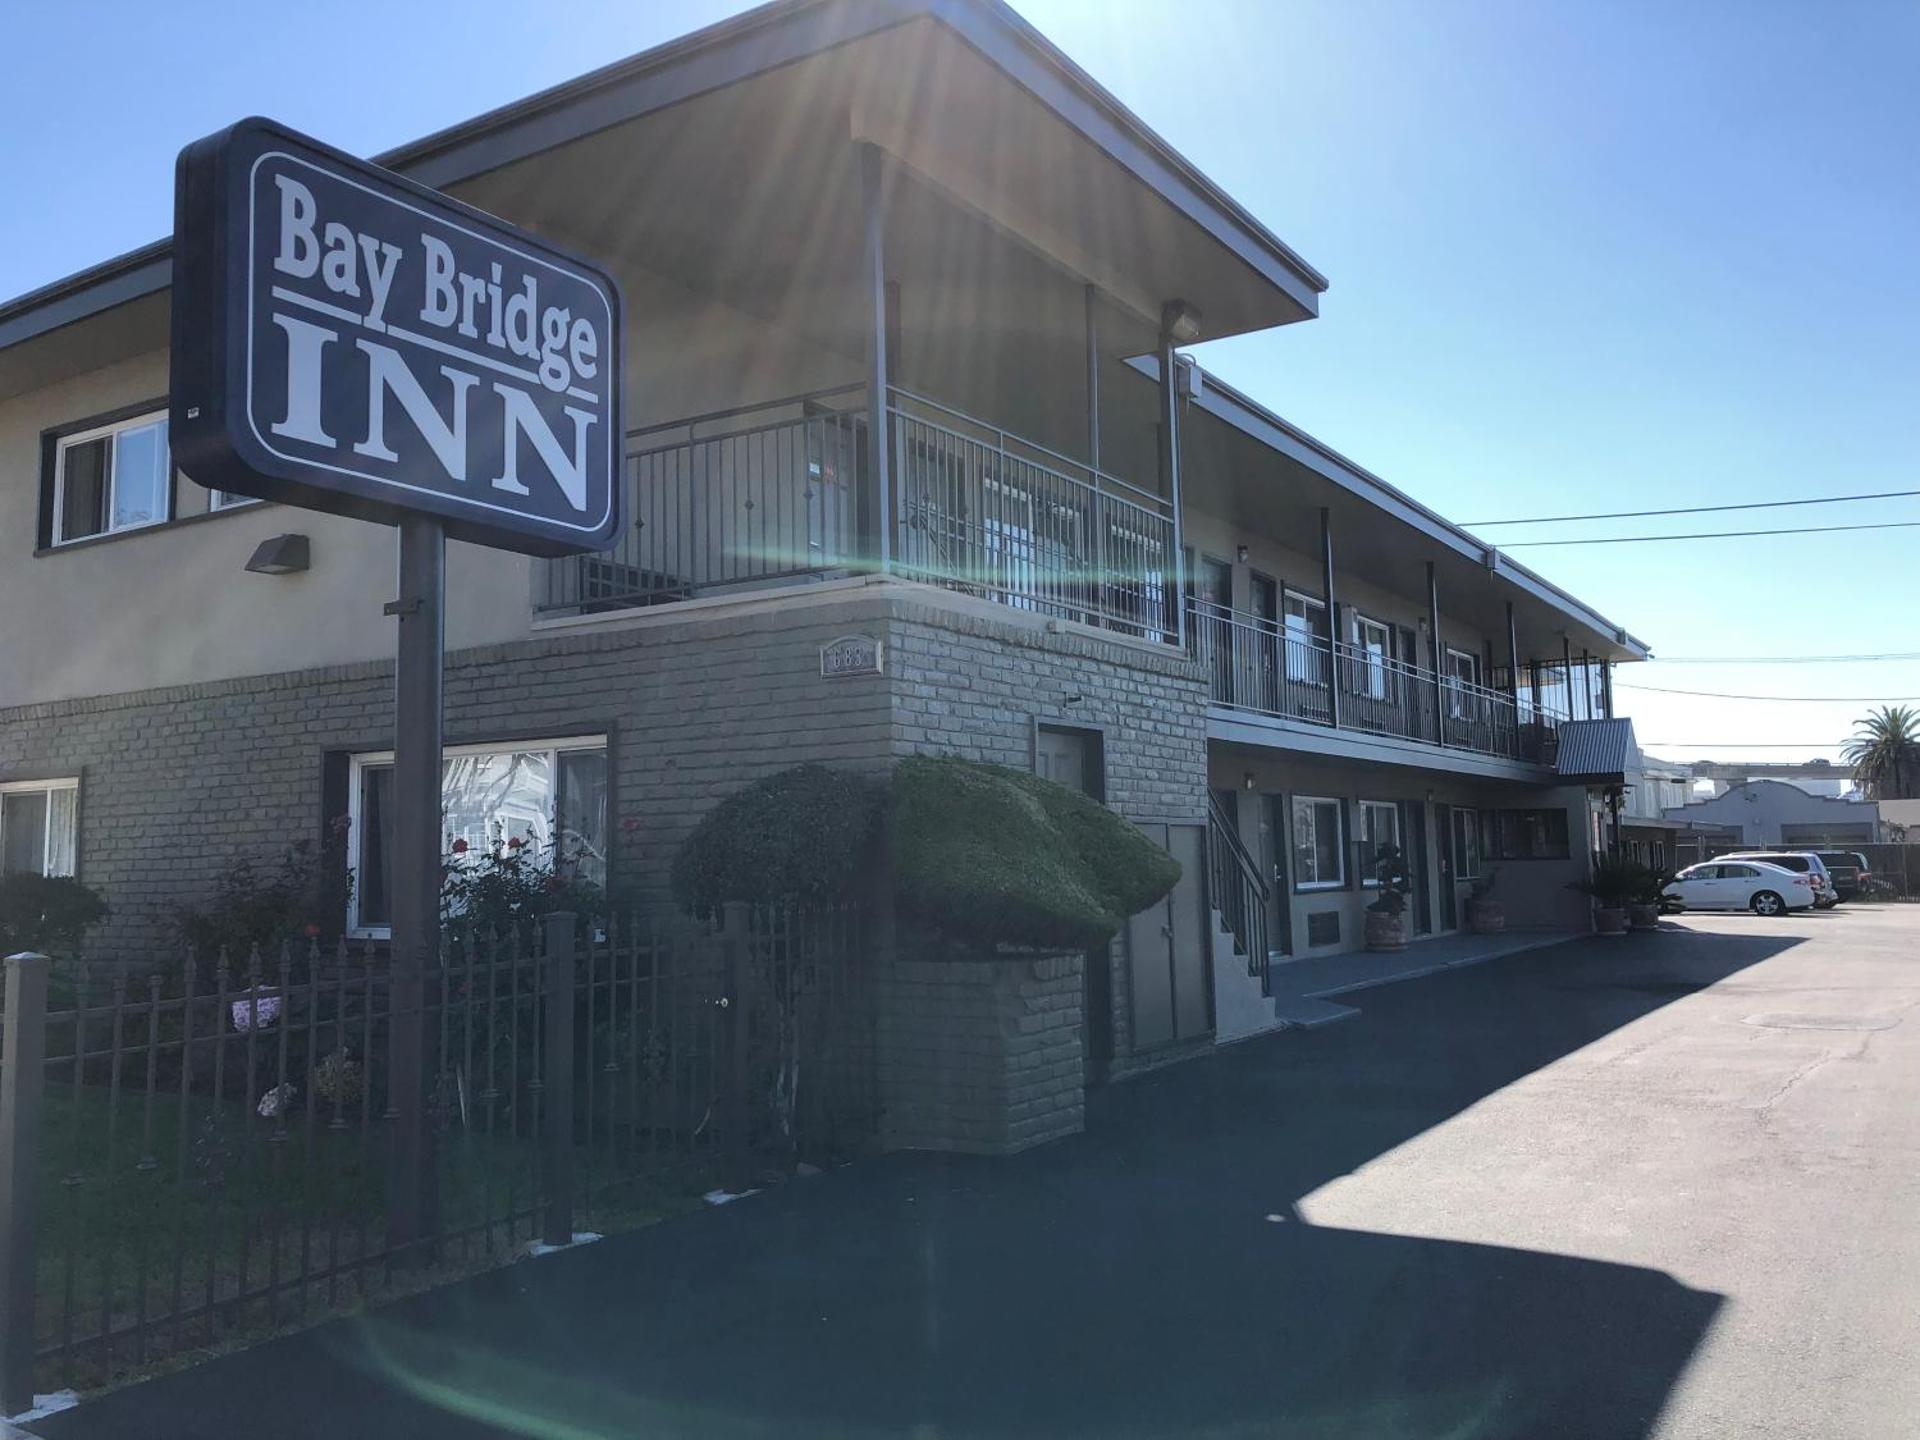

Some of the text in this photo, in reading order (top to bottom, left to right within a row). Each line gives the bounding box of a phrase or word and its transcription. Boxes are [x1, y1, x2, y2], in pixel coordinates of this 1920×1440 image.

[274, 174, 597, 393] Bay Bridge
[271, 313, 598, 512] INN
